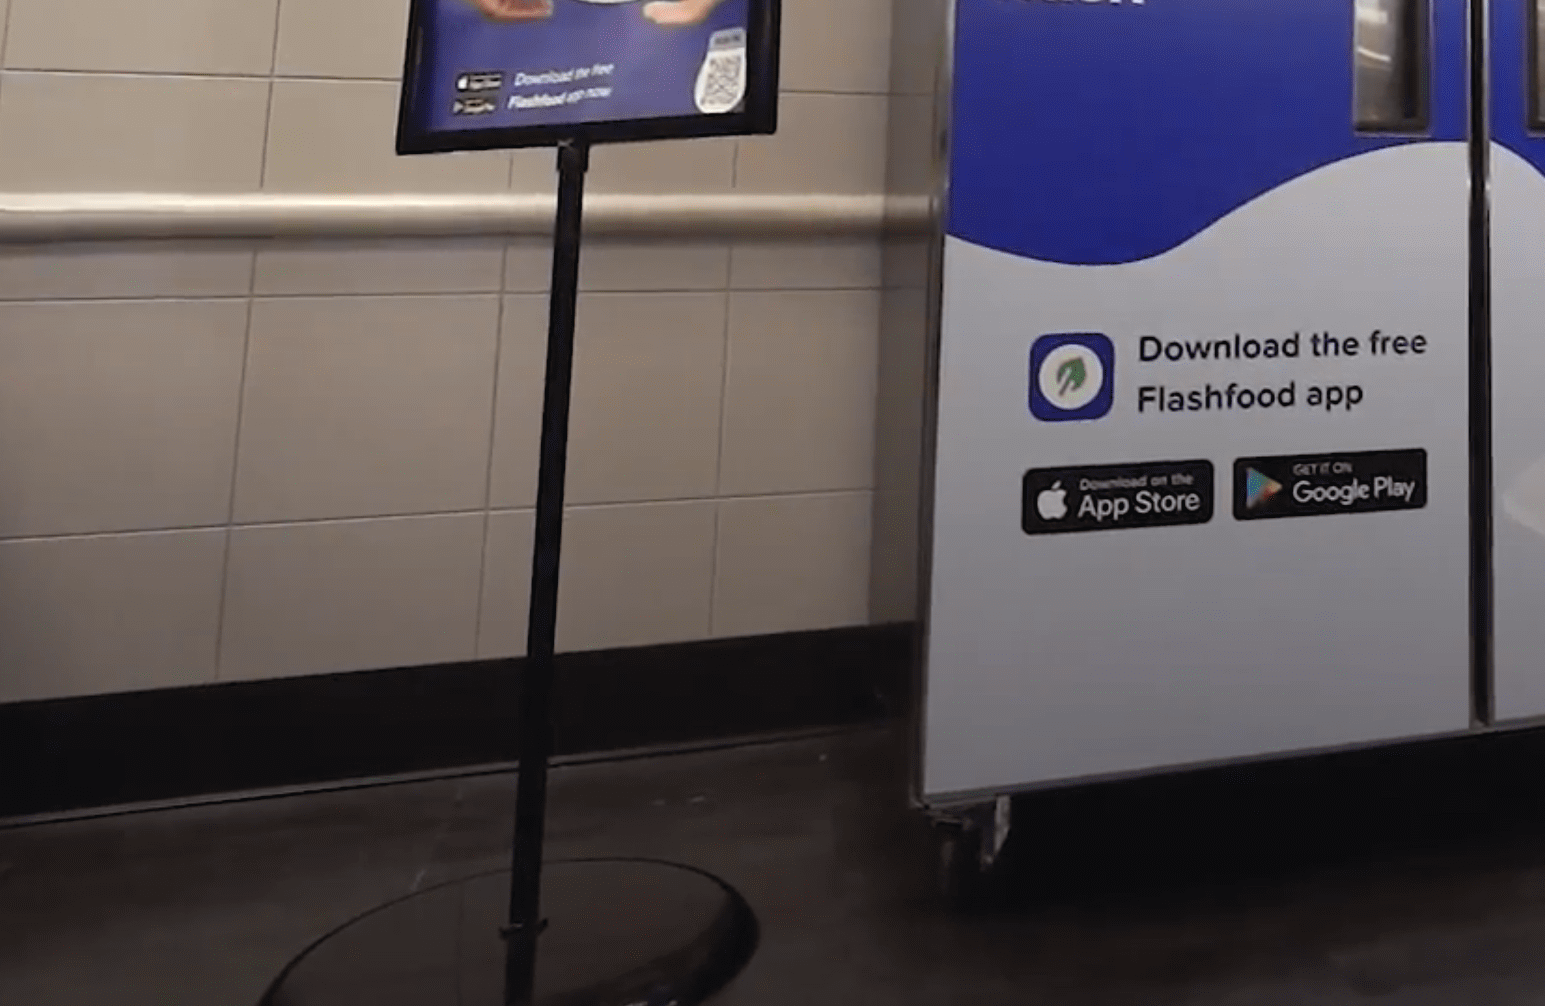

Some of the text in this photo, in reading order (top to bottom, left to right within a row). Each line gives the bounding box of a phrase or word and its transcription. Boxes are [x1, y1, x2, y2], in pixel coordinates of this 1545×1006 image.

[1139, 330, 1427, 362] Download the free
[1139, 382, 1364, 413] Flashfood app
[1079, 472, 1194, 491] Download on the
[1332, 461, 1353, 474] ON
[1077, 490, 1200, 522] App Store
[1293, 475, 1416, 506] Google Play
